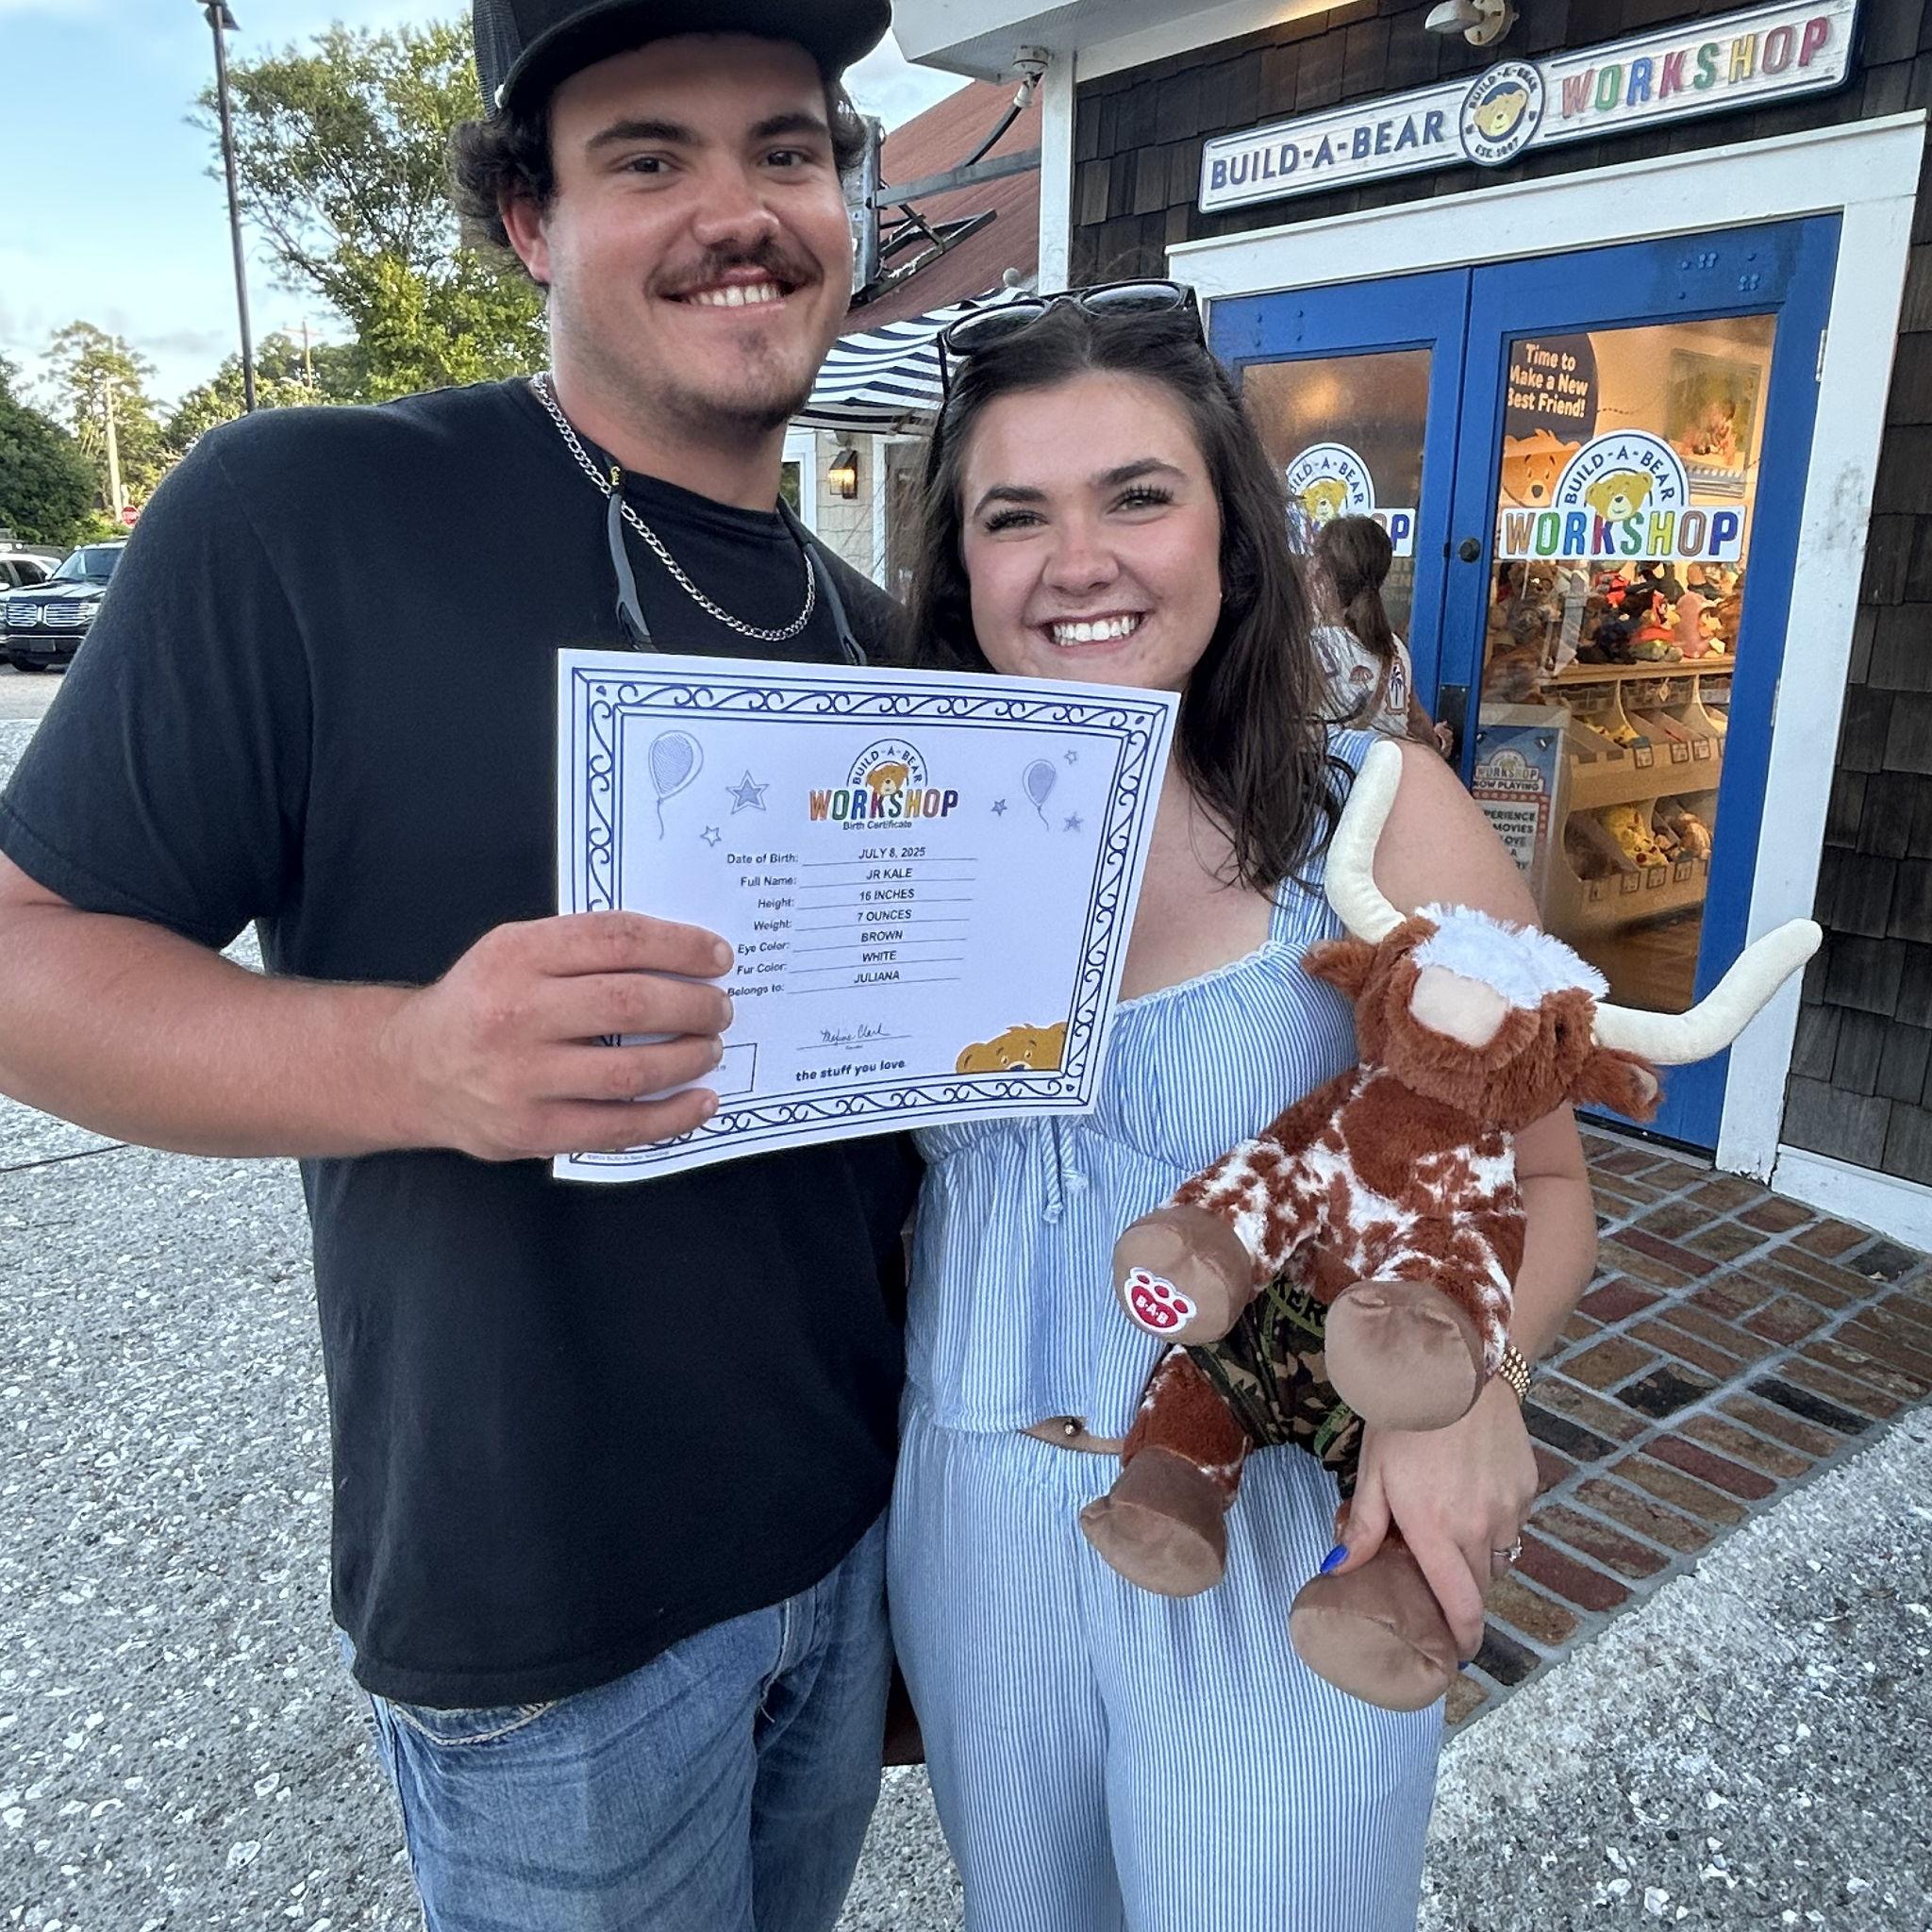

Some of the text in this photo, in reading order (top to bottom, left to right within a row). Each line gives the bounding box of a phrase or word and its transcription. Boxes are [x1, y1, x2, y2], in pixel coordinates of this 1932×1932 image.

[1210, 16, 1829, 190] BUILD-A-BEAR WORKSHOP
[1525, 342, 1577, 372] Time to
[1546, 375, 1556, 391] a
[1557, 373, 1589, 396] New
[1538, 392, 1586, 419] Friend!
[1563, 444, 1675, 506] BUILD-A-BEAR
[1506, 509, 1739, 558] WORKSHOP
[852, 745, 924, 786] BUILD-A-BEAR
[1498, 780, 1540, 791] PLAYING
[808, 788, 959, 822] WORKSHOP
[1484, 809, 1536, 822] PERIENCE
[842, 819, 913, 831] Birth Certificate
[726, 852, 799, 864] Date of Birth:
[858, 847, 888, 859] JULY
[901, 846, 926, 858] 2025
[866, 867, 913, 880] JR KALE
[741, 875, 797, 887] Full Name:
[859, 888, 915, 902] 16 INCHES
[758, 897, 795, 910] Height:
[857, 908, 912, 923] 7 OUNCES
[754, 919, 792, 932] Weight:
[860, 929, 904, 943] BROWN
[738, 941, 791, 956] Eye Color:
[862, 949, 897, 963] WHITE
[737, 962, 788, 975] Fur Color:
[854, 970, 900, 984] JULIANA
[727, 983, 785, 997] Belongs to:
[795, 1069, 818, 1082] the
[820, 1063, 853, 1079] stuff
[855, 1061, 877, 1077] you
